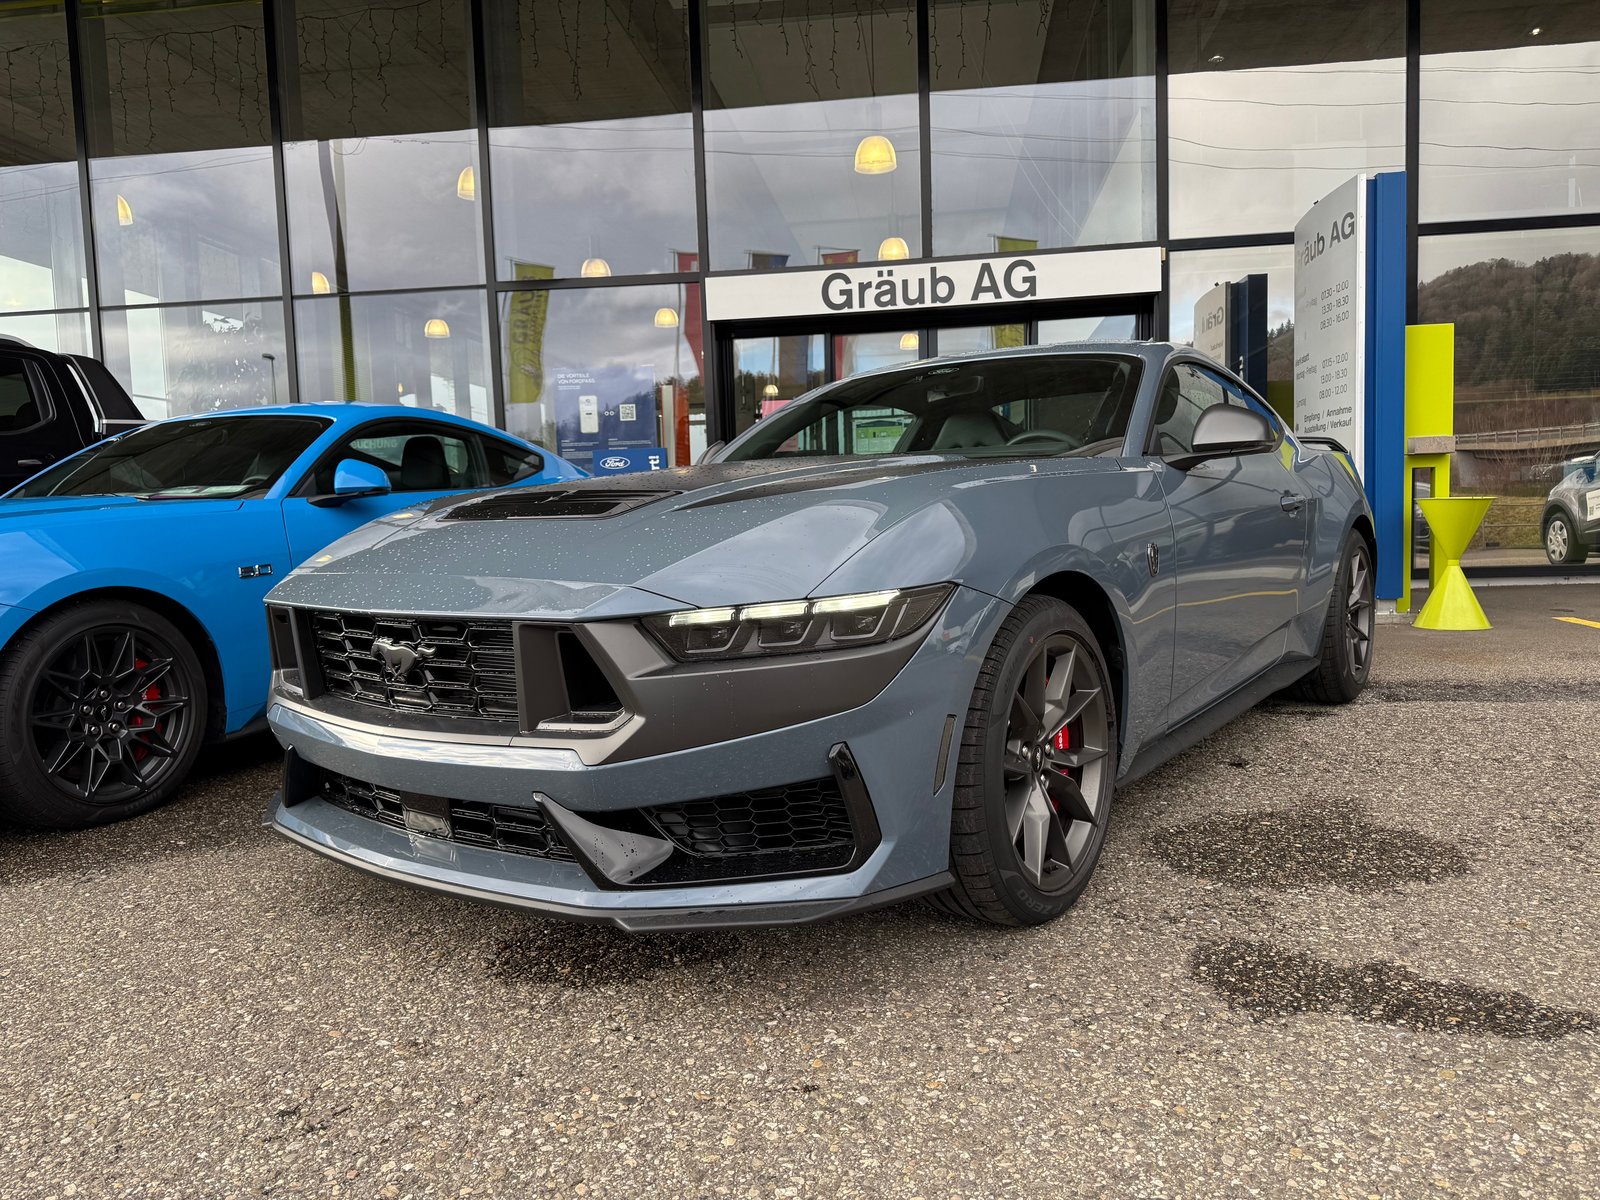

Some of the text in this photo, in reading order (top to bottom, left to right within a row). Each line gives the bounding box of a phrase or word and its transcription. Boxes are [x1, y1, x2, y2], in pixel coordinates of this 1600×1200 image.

[1329, 211, 1355, 249] AG
[821, 259, 1038, 311] Gräub AG
[1335, 279, 1350, 293] 12.00
[1335, 351, 1349, 365] 12.00
[1334, 383, 1348, 396] 12.00
[1303, 412, 1321, 424] Empfang
[1326, 406, 1353, 418] Annahme
[1329, 416, 1353, 429] Verkauf
[238, 564, 274, 578] 5.0
